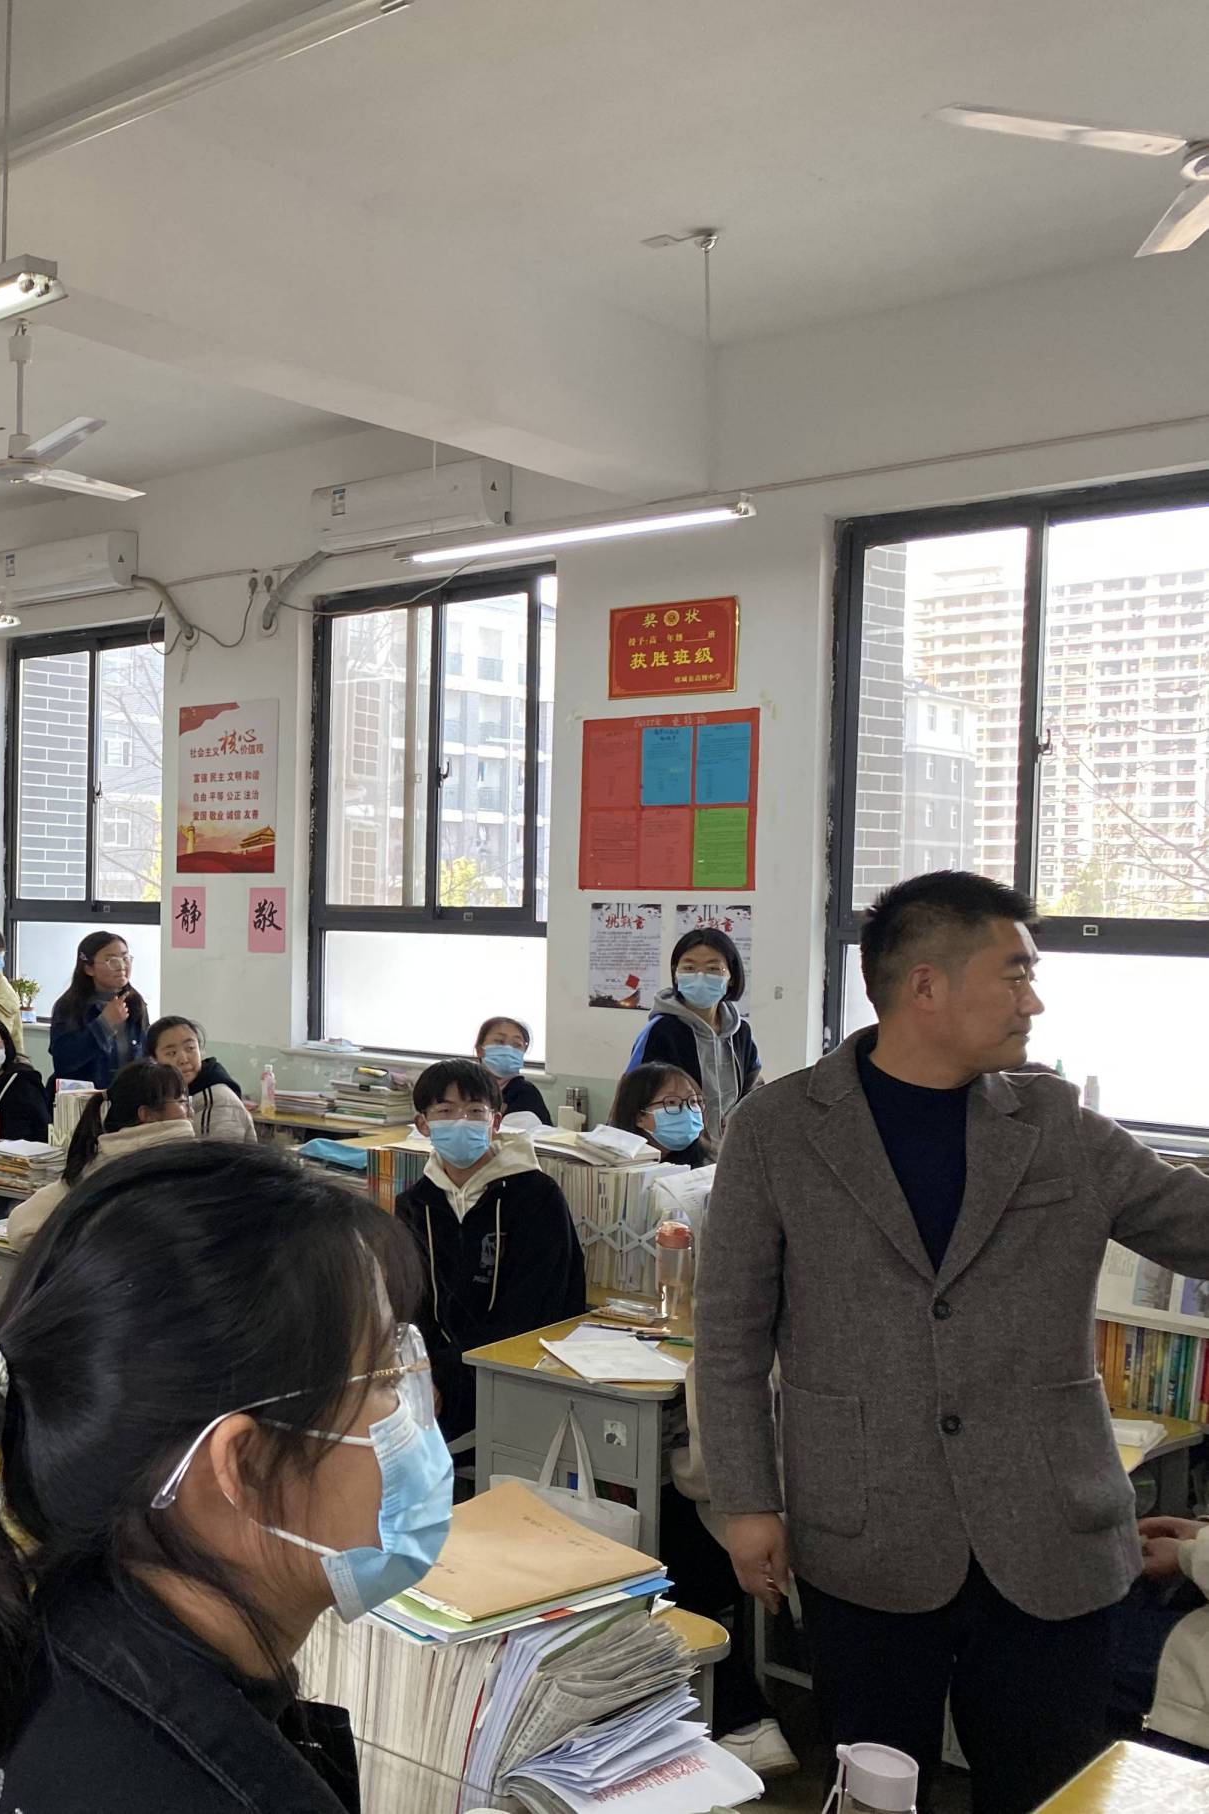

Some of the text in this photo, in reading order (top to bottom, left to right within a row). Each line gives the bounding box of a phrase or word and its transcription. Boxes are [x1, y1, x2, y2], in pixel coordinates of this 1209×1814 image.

[630, 647, 714, 669] 获胜班级
[190, 747, 220, 758] 社会主义
[240, 744, 264, 755] 价值观
[193, 769, 260, 784] 富强 民主 文明 和谐
[193, 790, 260, 802] 自由 平等 公正 法治
[193, 809, 260, 821] 爱国 敬业 诚信 友善
[175, 898, 202, 935] 静
[253, 899, 283, 933] 敬
